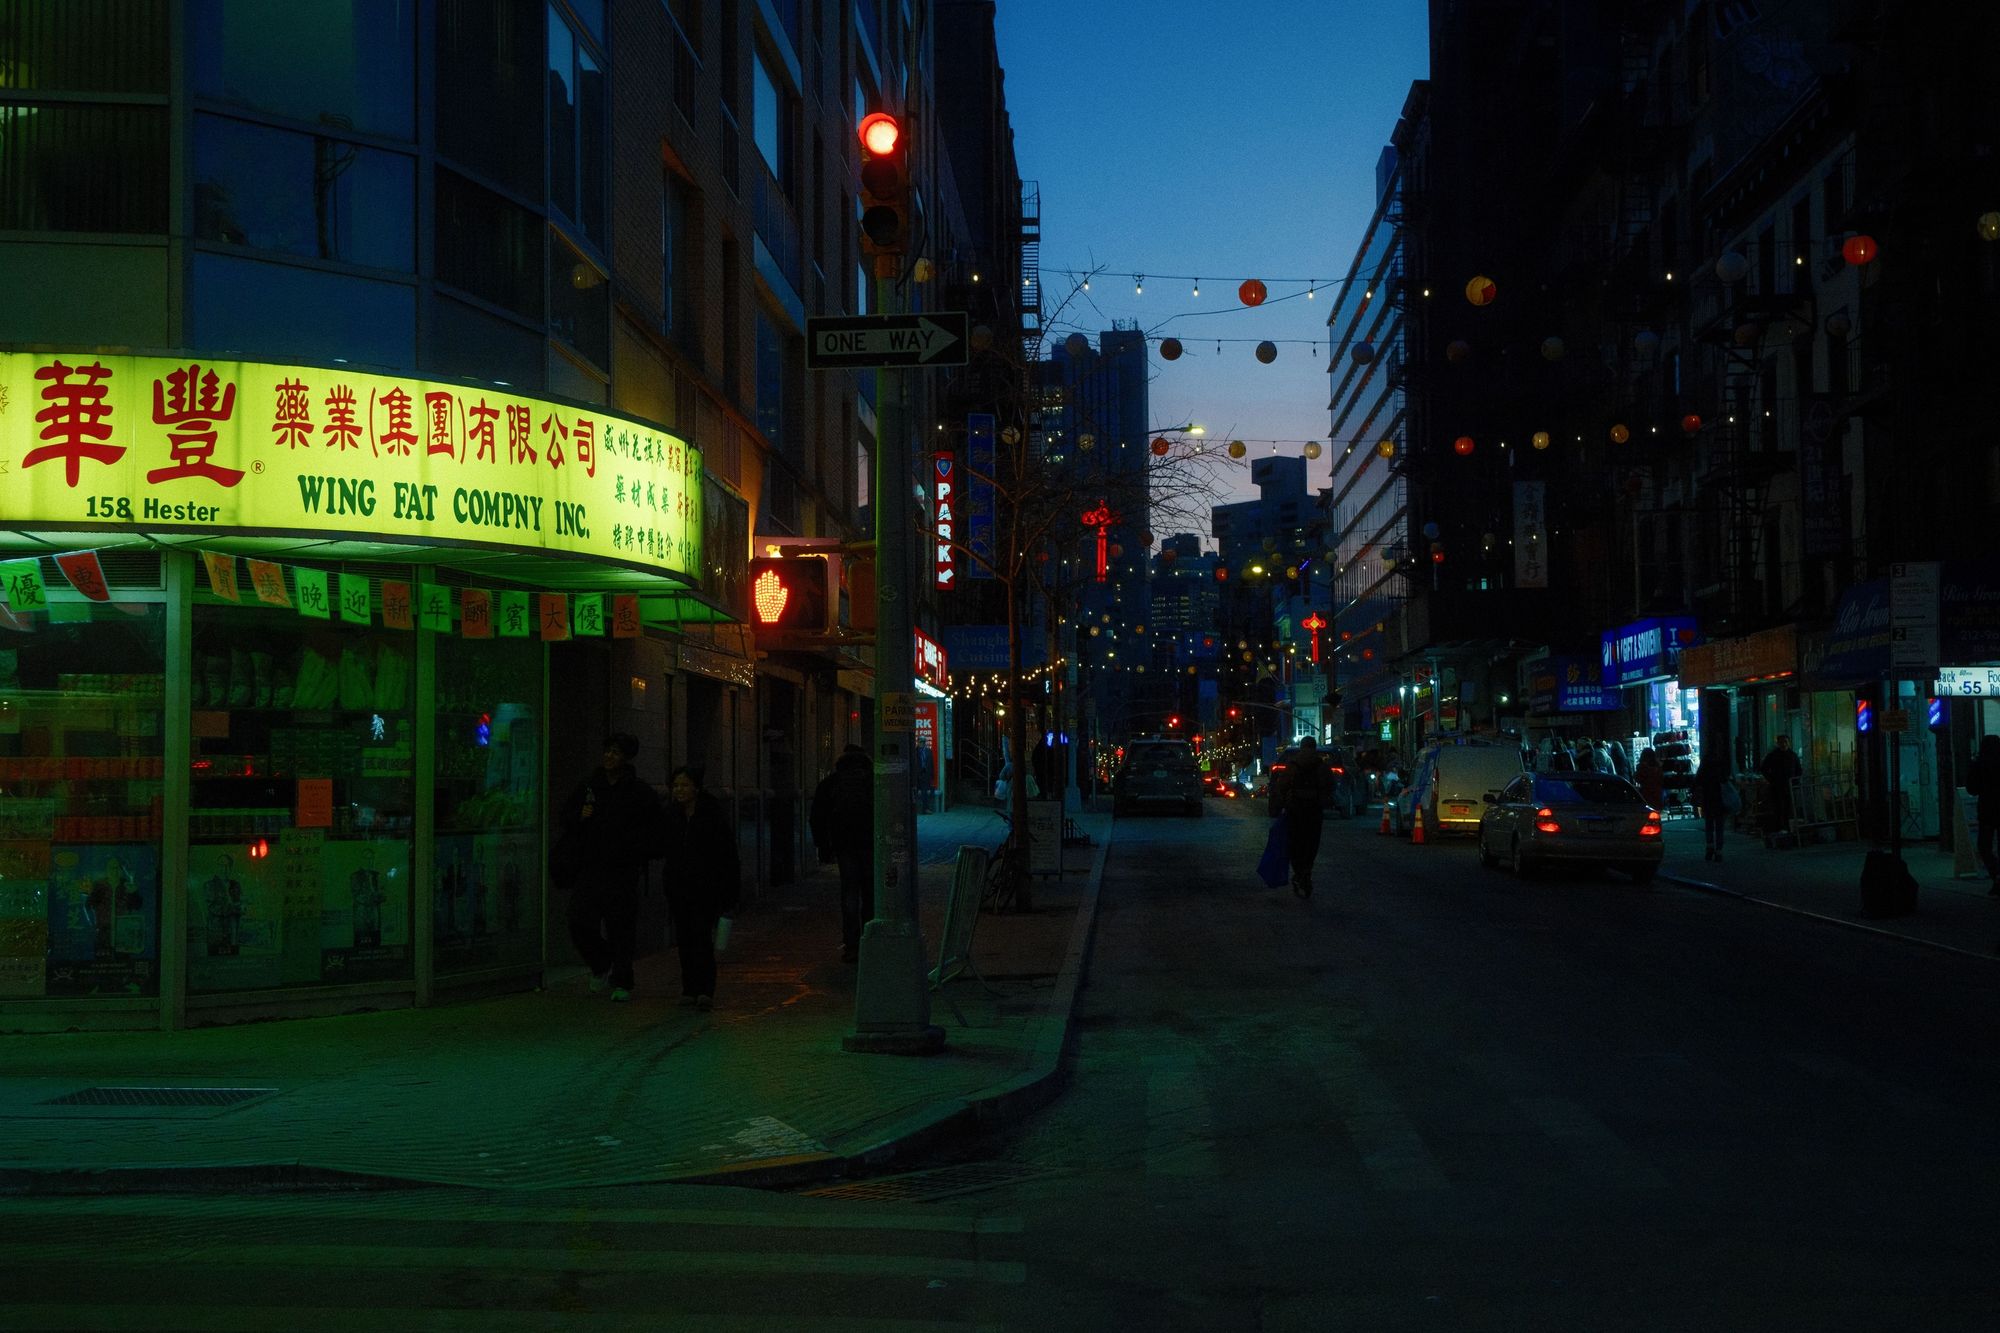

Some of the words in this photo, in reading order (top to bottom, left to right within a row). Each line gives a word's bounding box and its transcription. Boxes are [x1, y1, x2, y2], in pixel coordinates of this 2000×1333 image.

[824, 332, 867, 353] ONE
[888, 329, 934, 349] WAY
[22, 360, 246, 488] 華豐
[86, 496, 131, 519] 158
[144, 497, 220, 522] Hester
[298, 475, 376, 517] WING
[395, 482, 438, 522] FAT
[453, 488, 544, 532] COMPNY
[555, 500, 591, 538] INC.
[936, 481, 953, 565] PARK
[1938, 683, 1953, 697] Rub
